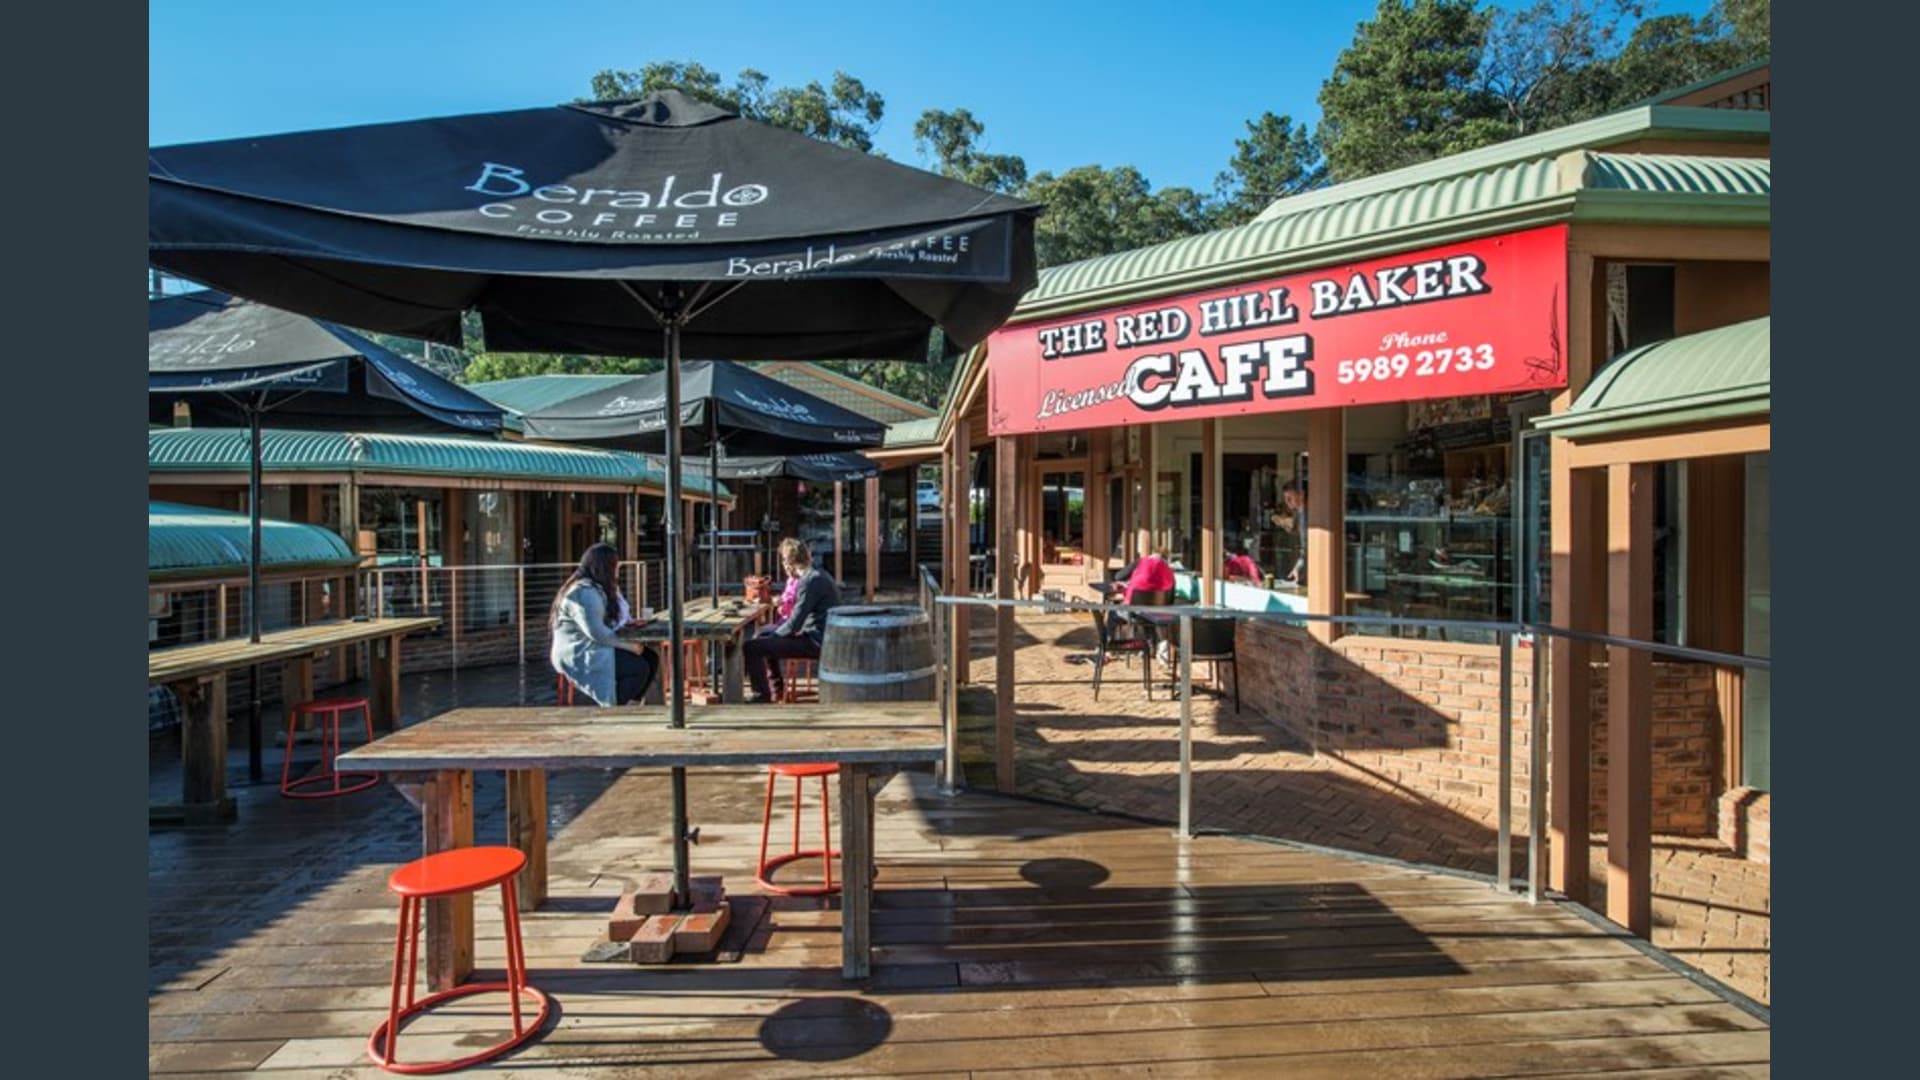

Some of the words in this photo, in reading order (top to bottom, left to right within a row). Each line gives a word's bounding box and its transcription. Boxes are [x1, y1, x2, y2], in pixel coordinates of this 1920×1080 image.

[464, 161, 769, 210] Beraldo
[477, 202, 740, 228] COFFEE
[514, 223, 600, 239] Freshly
[610, 229, 700, 241] Roasted
[725, 243, 857, 277] Beraldo
[917, 249, 958, 263] Roasted
[1039, 317, 1107, 360] THE
[1114, 308, 1192, 348] RED
[1199, 288, 1299, 335] HILL
[1309, 253, 1492, 320] BAKER
[1378, 330, 1449, 351] Phone
[1037, 364, 1138, 420] Licensed
[1124, 333, 1315, 412] CAFE
[1337, 351, 1410, 385] 5989
[1415, 342, 1496, 377] 2733
